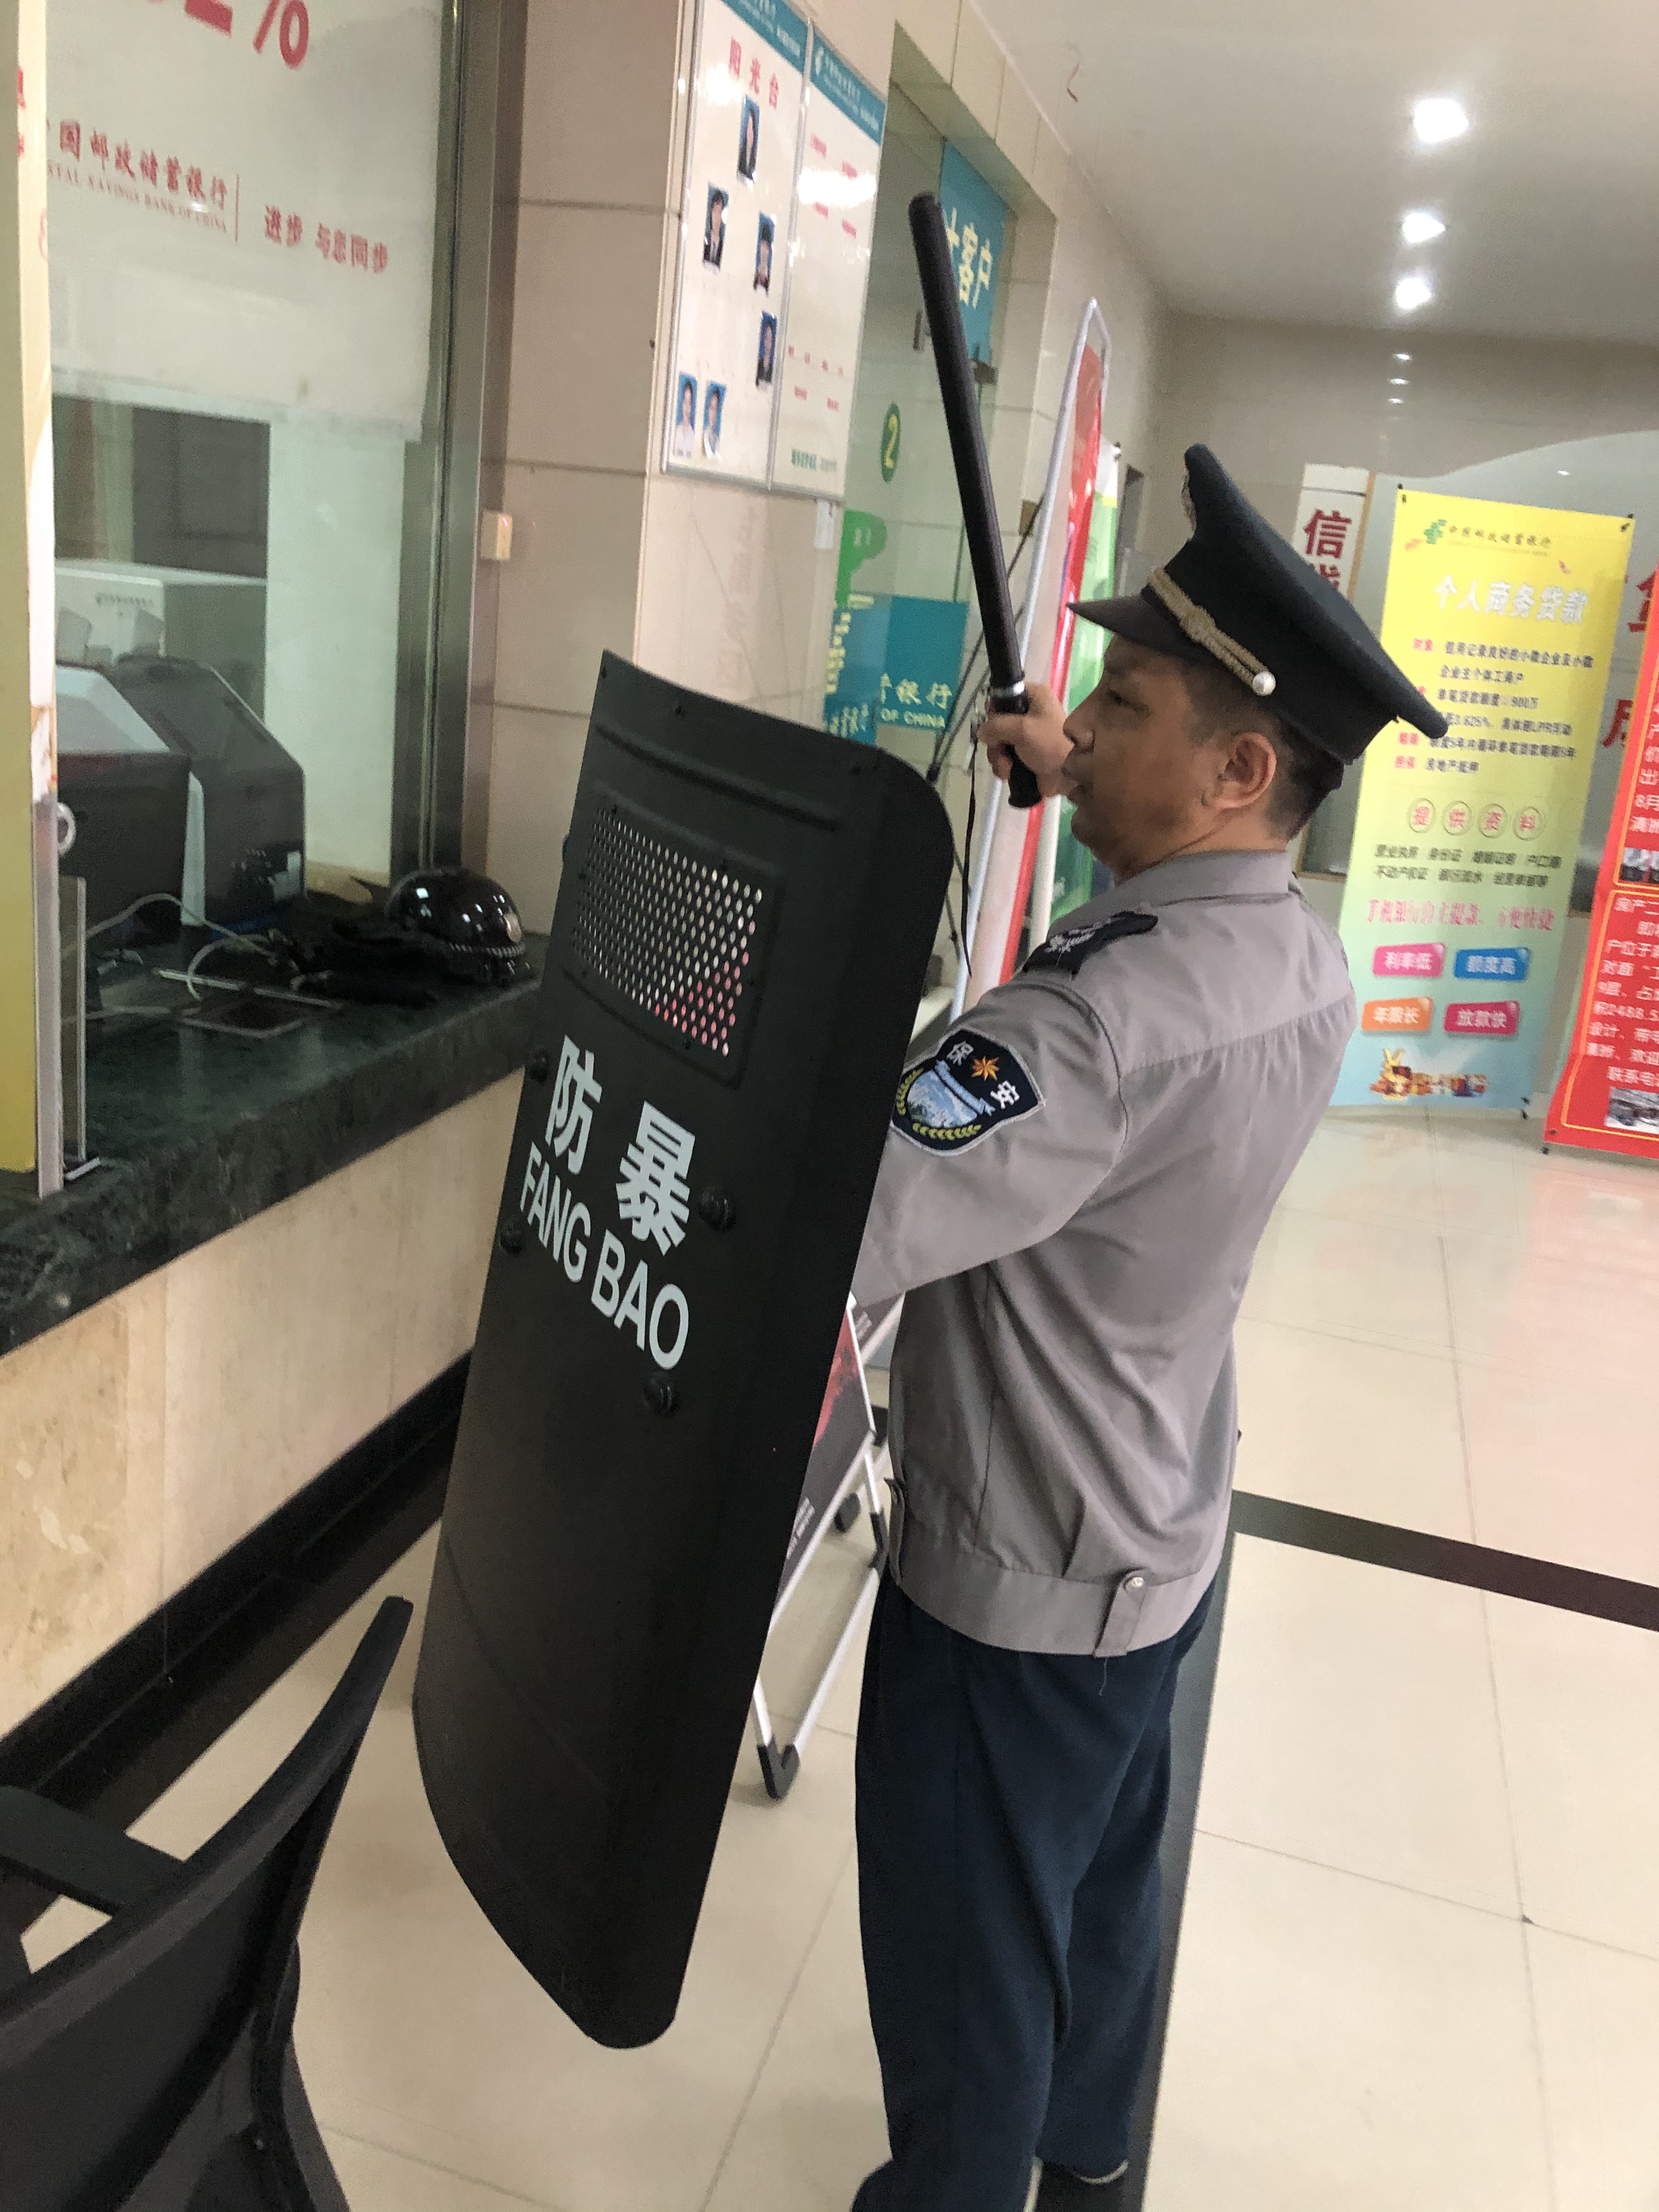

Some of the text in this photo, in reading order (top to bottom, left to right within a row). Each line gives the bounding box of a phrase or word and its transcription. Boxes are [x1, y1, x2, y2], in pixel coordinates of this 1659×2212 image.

[46, 118, 227, 210] 国邮政储蓄银行
[1434, 574, 1589, 623] 个人商务贷款
[545, 1035, 696, 1257] 防暴
[520, 1141, 689, 1370] FANG BAO
